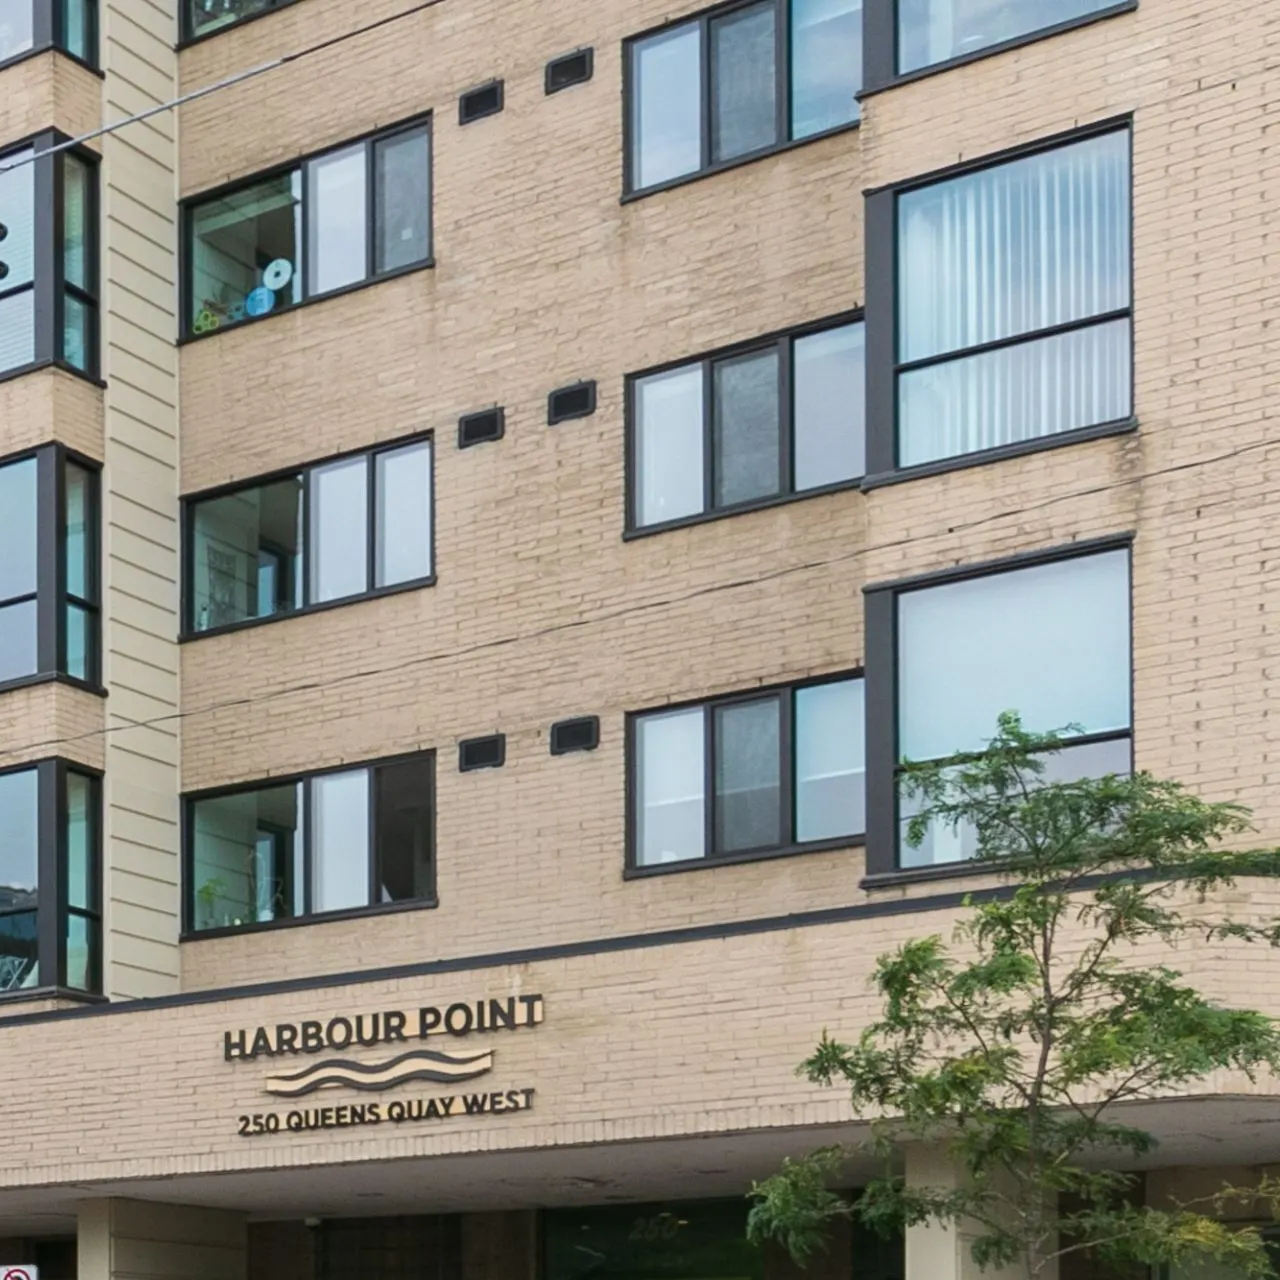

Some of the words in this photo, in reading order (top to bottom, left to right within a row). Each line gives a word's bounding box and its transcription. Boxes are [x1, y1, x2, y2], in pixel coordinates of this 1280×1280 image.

[224, 1009, 408, 1062] HARBOUR
[418, 993, 544, 1040] POINT
[239, 1112, 280, 1137] 250
[286, 1103, 381, 1132] QUEENS
[387, 1095, 455, 1124] QUAY
[461, 1088, 536, 1116] WEST
